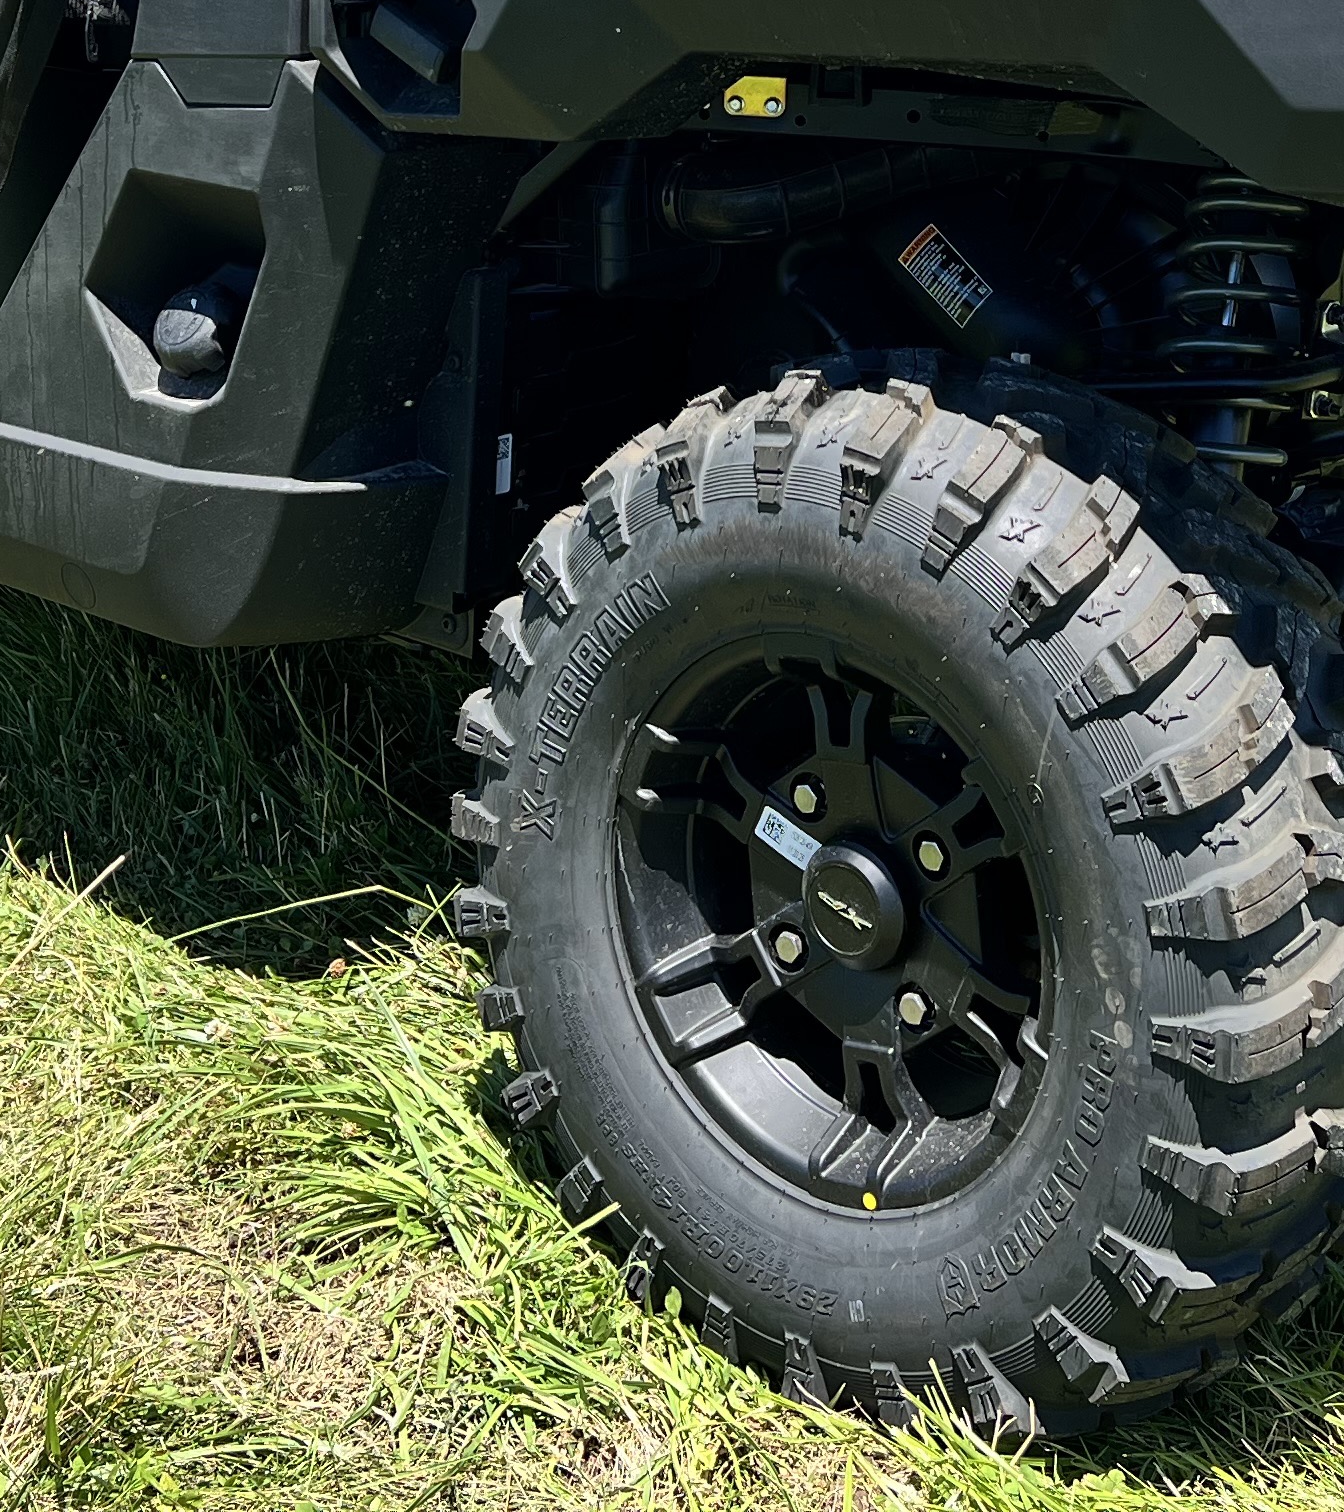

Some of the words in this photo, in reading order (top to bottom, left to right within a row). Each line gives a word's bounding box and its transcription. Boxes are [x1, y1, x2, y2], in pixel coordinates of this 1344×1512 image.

[519, 569, 672, 841] X-TERRAIN
[1074, 1029, 1119, 1148] PRO
[972, 1139, 1089, 1293] ARMOR
